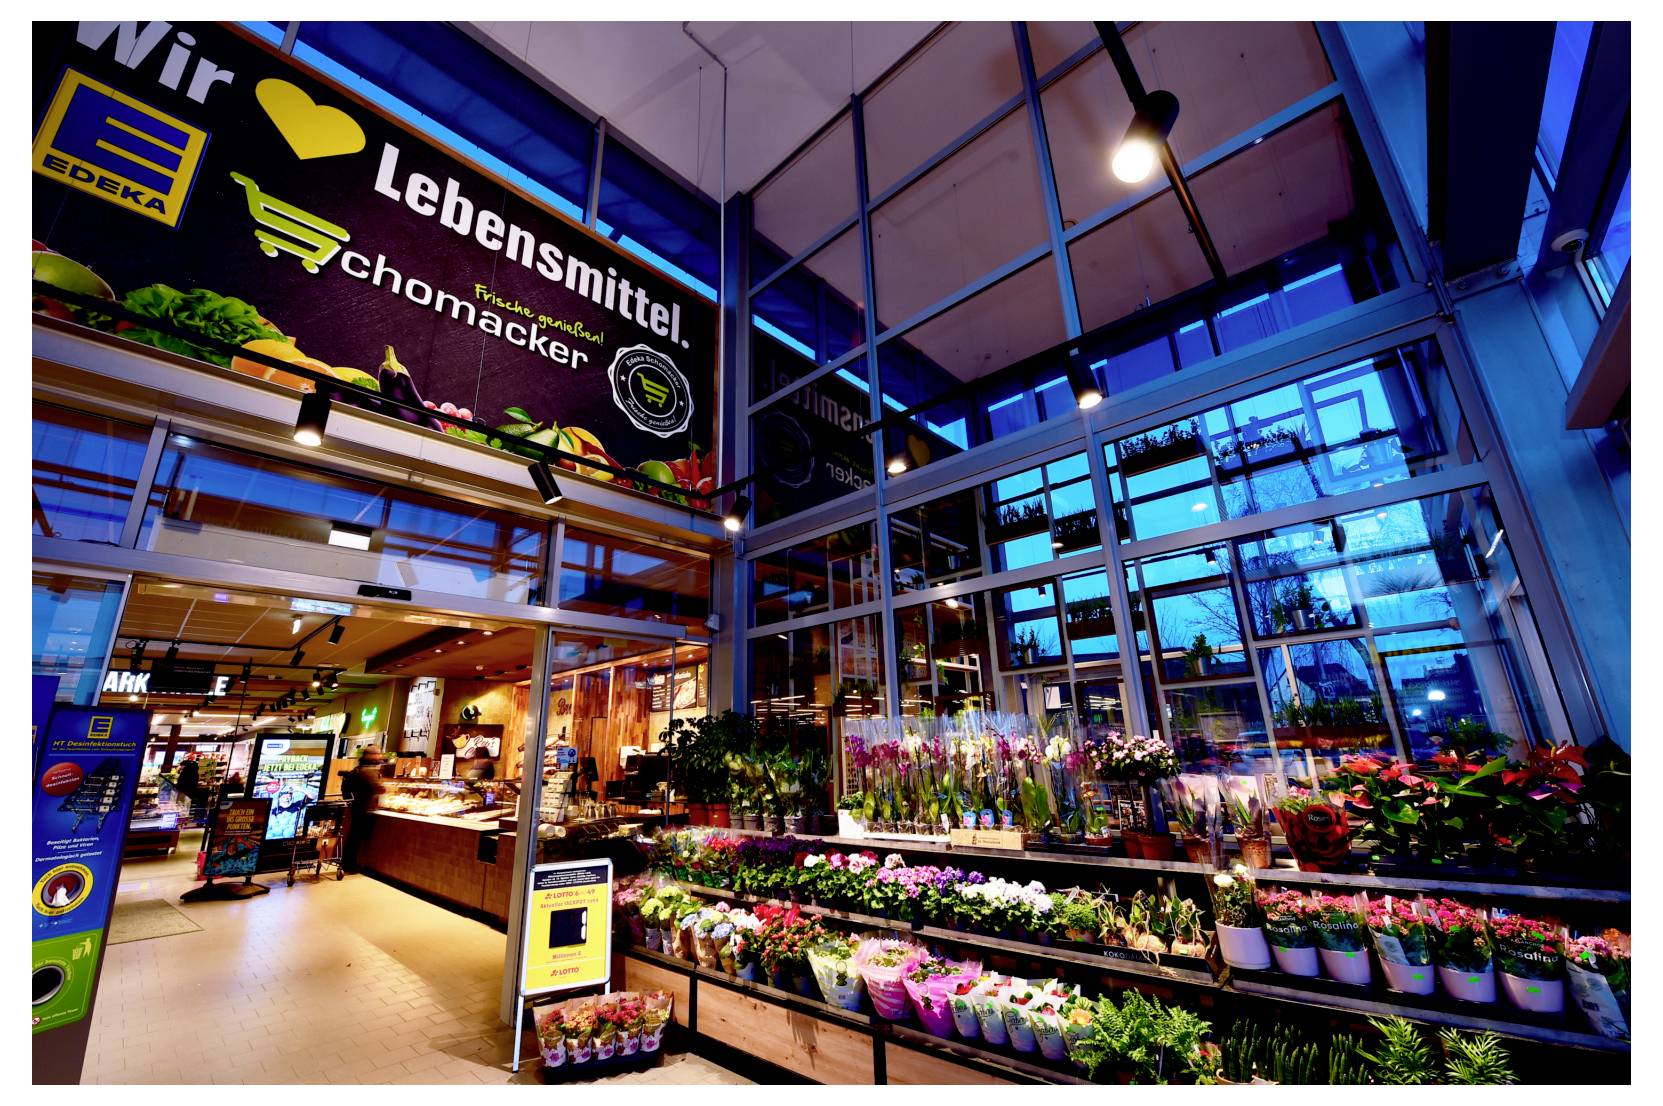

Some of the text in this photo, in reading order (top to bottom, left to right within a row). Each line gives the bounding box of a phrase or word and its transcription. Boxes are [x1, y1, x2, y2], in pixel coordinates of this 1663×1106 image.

[76, 21, 235, 104] Wir
[42, 154, 166, 214] EDEKA
[374, 142, 690, 349] Lebensmittel.
[475, 283, 604, 346] Frische genießen!
[625, 355, 681, 389] Edeka Schomacker
[553, 891, 573, 899] LOTTO
[559, 967, 579, 976] LOTTO
